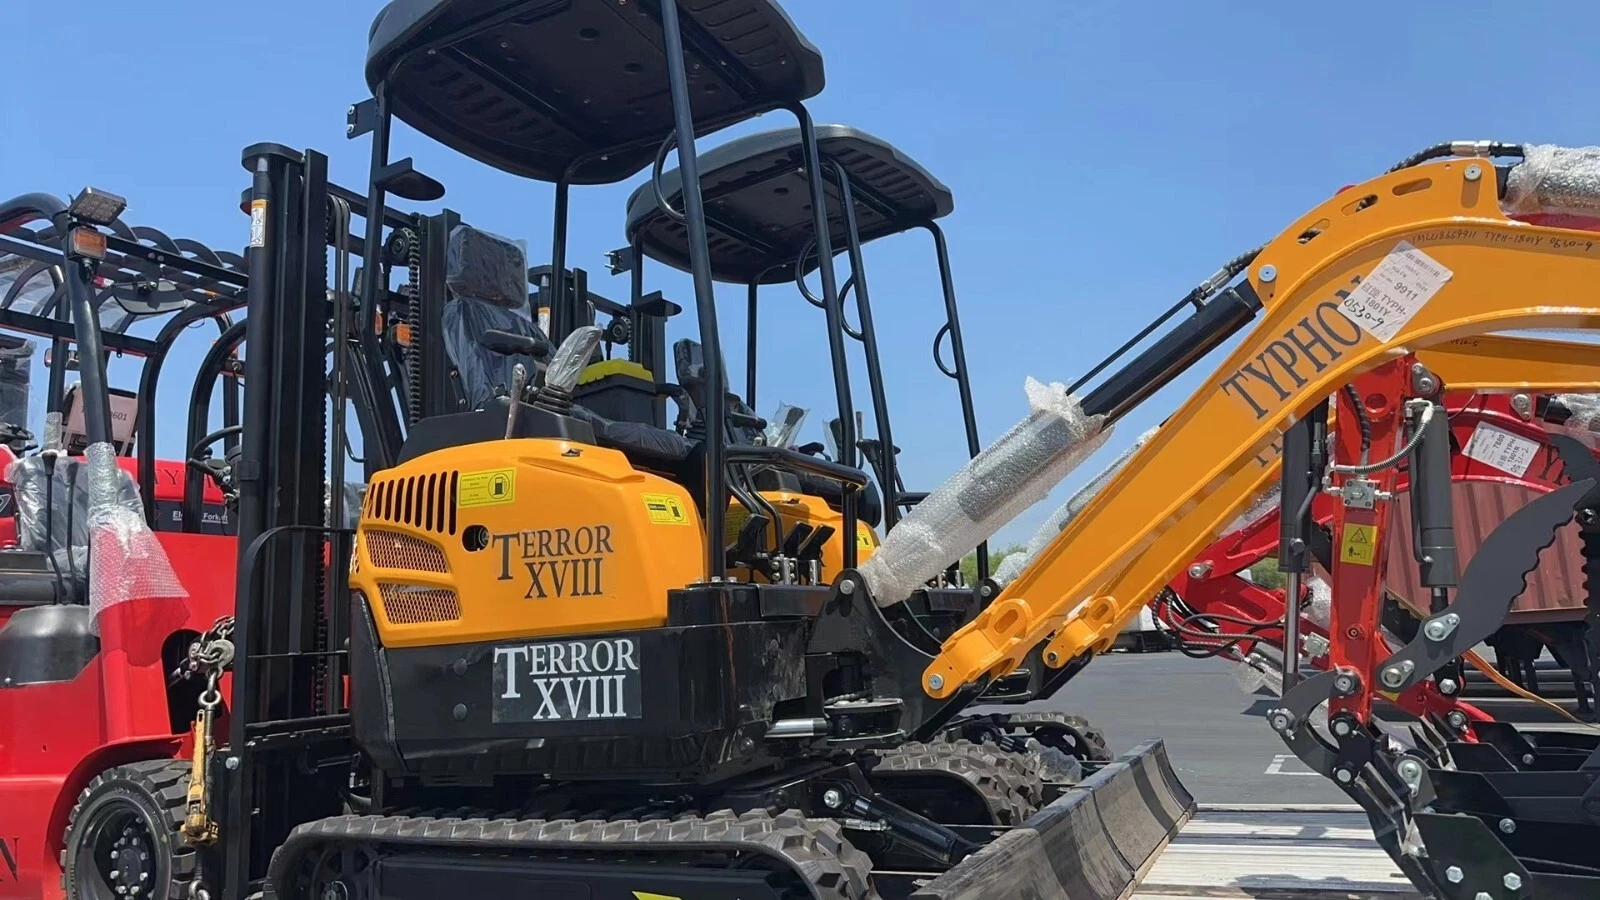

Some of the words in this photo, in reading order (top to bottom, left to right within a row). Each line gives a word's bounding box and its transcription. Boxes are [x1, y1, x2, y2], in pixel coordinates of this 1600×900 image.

[1365, 296, 1392, 317] 1801Y
[1381, 293, 1406, 316] TYPH-
[1394, 281, 1419, 301] 9911
[1343, 298, 1385, 330] 0530-9
[1219, 274, 1362, 421] TYPHO
[492, 525, 614, 581] TERROR
[524, 557, 604, 600] XVIII
[493, 638, 639, 699] TERROR
[532, 674, 627, 720] XVIII
